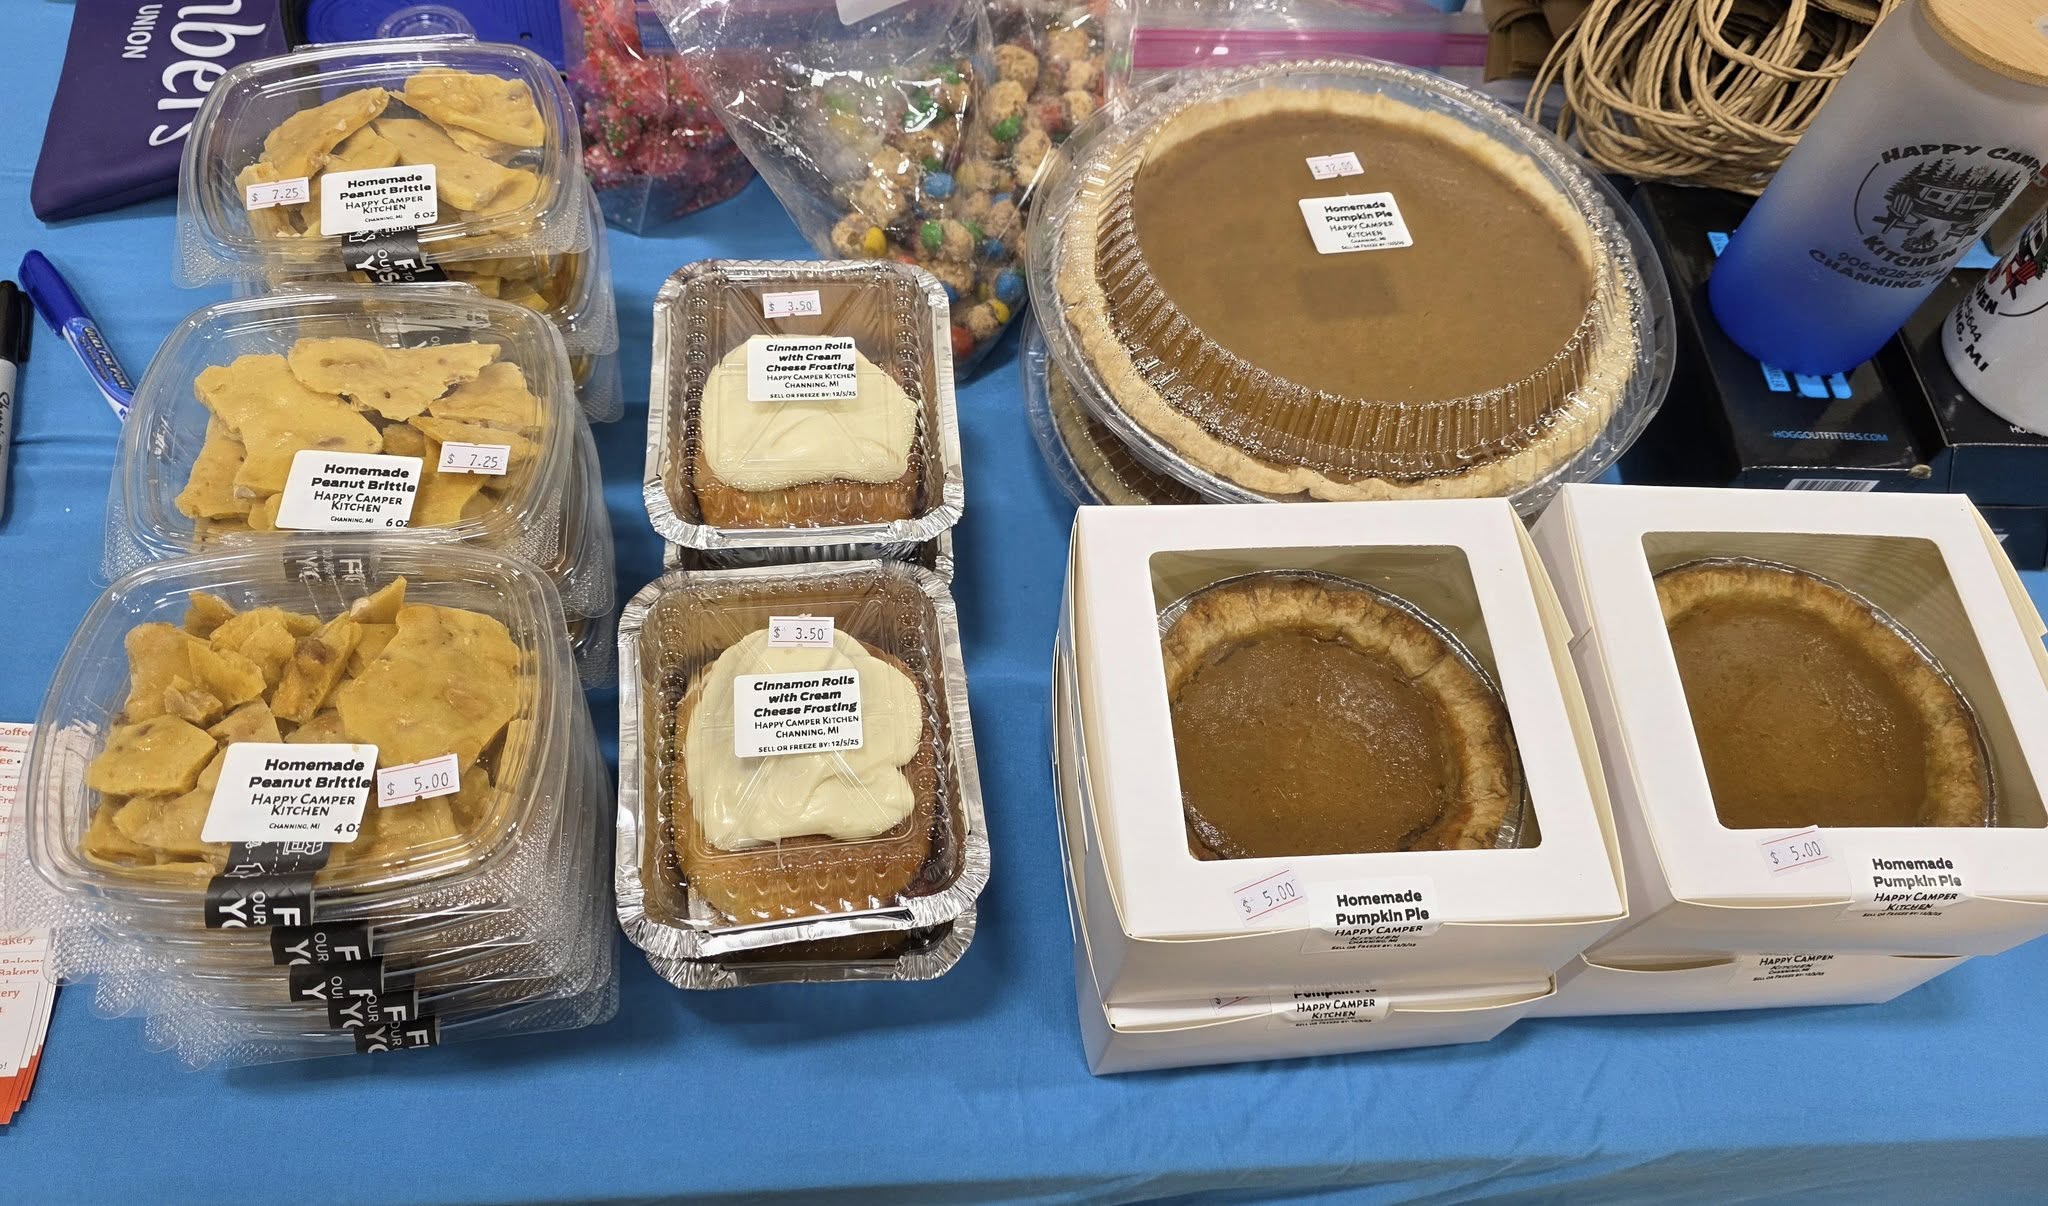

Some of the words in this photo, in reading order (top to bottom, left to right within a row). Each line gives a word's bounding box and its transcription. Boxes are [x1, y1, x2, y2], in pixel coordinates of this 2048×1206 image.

[122, 4, 163, 59] UNION
[1881, 143, 1982, 164] HAPPY
[347, 173, 423, 189] Homemade
[251, 192, 258, 203] $
[272, 187, 299, 200] 7.25
[339, 187, 387, 200] Peanut
[389, 182, 432, 195] Brittle
[345, 199, 379, 211] HAPPY
[381, 195, 423, 206] CAMPER
[363, 203, 407, 215] KITCHEN
[1324, 201, 1386, 213] Homemade
[414, 211, 421, 220] 6
[1325, 212, 1375, 223] Pumpkin
[1375, 209, 1393, 218] Pie
[1330, 224, 1358, 232] HAPPY
[1359, 220, 1394, 229] CAMPER
[1346, 230, 1384, 238] KITCHEN
[1862, 235, 1958, 267] KITCHEN
[1808, 248, 1925, 289] CHANNING,
[769, 302, 775, 312] $
[788, 300, 813, 311] 3.50
[766, 344, 823, 352] Cinnamon
[824, 342, 853, 350] Rolls
[779, 354, 804, 362] with
[805, 353, 841, 361] Cream
[1964, 343, 1989, 372] MI
[766, 364, 807, 372] Cheese
[808, 362, 855, 371] Frosting
[793, 373, 824, 381] CAMPER
[784, 381, 828, 389] CHANNING,
[1771, 430, 1889, 442] HOGGOUTFITTERS.COM
[447, 453, 455, 465] $
[470, 453, 499, 469] 7.25
[323, 463, 410, 479] Homemade
[311, 477, 365, 490] Peanut
[367, 480, 416, 494] Brittle
[314, 490, 354, 502] HAPPY
[355, 492, 403, 506] CAMPER
[331, 500, 381, 513] KITCHEN
[385, 518, 393, 528] 6
[773, 627, 781, 639] $
[795, 627, 824, 641] 3.50
[753, 679, 820, 691] Cinnamon
[821, 675, 855, 687] Rolls
[768, 692, 798, 704] with
[800, 690, 842, 701] Cream
[753, 706, 802, 718] Cheese
[803, 701, 858, 714] Frosting
[754, 721, 785, 730] HAPPY
[785, 717, 821, 727] CAMPER
[822, 715, 859, 725] KITCHEN
[775, 729, 826, 739] CHANNING,
[827, 726, 839, 735] MI
[789, 743, 817, 751] FREEZE
[831, 738, 859, 747] 12/5/25
[264, 758, 365, 773] Homemade
[249, 776, 312, 790] Peanut
[315, 776, 372, 789] Brittle
[387, 782, 395, 797] $
[414, 771, 450, 793] 5.00
[251, 793, 298, 807] HAPPY
[300, 793, 356, 806] CAMPER
[270, 805, 330, 817] KITCHEN
[269, 822, 309, 831] CHANNING,
[334, 823, 342, 834] 4
[1770, 851, 1779, 865] $
[1789, 840, 1822, 861] 5.00
[1872, 857, 1954, 871] Homemade
[1873, 874, 1937, 891] Pumpkin
[1939, 873, 1962, 887] Pie
[1242, 897, 1252, 914] $
[1262, 881, 1296, 907] 5.00
[1336, 890, 1423, 908] Homemade
[1873, 892, 1912, 902] HAPPY
[1913, 891, 1958, 901] CAMPER
[252, 891, 267, 925] OUR
[1886, 903, 1934, 911] KITCHEN
[1335, 909, 1403, 926] Pumpkin
[1405, 907, 1430, 921] Pie
[1334, 927, 1375, 937] HAPPY
[1376, 925, 1423, 935] CAMPER
[313, 932, 330, 963] OUR
[1759, 956, 1793, 966] HAPPY
[364, 994, 380, 1023] OUR
[1296, 1002, 1331, 1013] HAPPY
[1333, 998, 1376, 1010] CAMPER
[1311, 1011, 1357, 1019] KITCHEN
